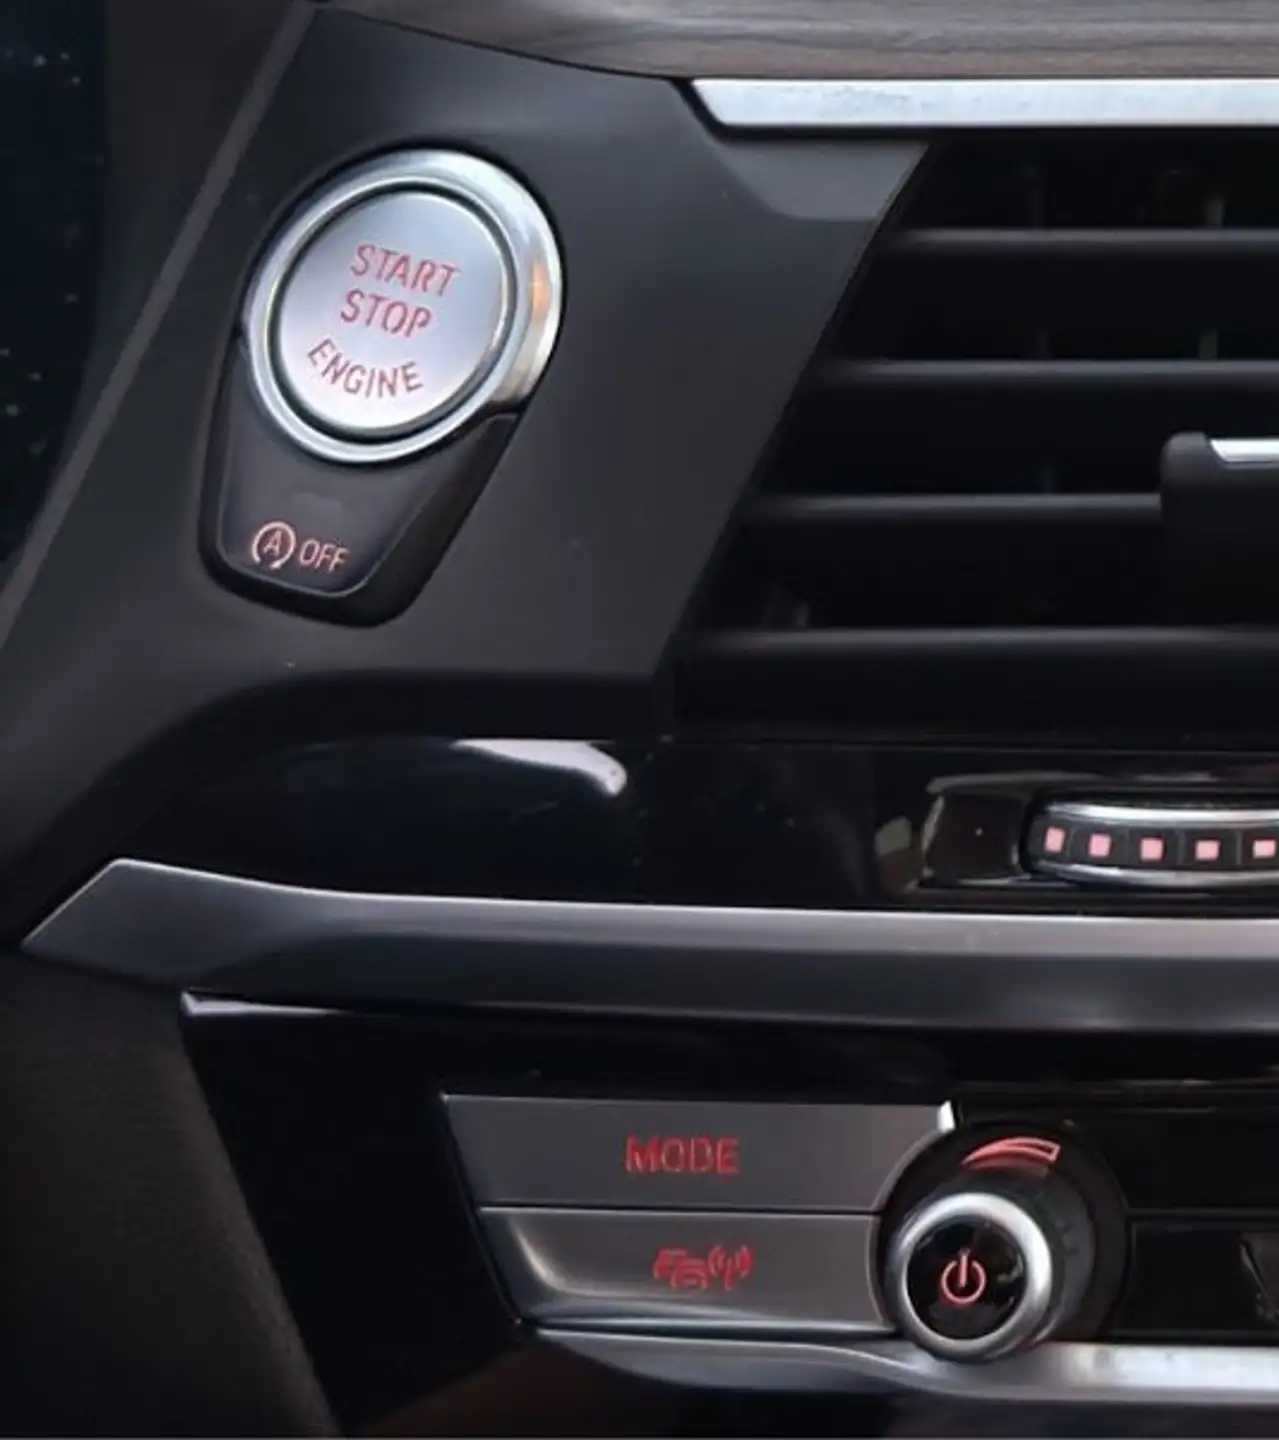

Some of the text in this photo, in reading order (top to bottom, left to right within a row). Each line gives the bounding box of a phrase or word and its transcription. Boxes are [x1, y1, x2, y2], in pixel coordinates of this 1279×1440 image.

[350, 243, 461, 298] START
[340, 289, 433, 339] STOP
[306, 337, 424, 399] ENGINE
[298, 537, 349, 573] OFF
[623, 1133, 742, 1175] MODE
